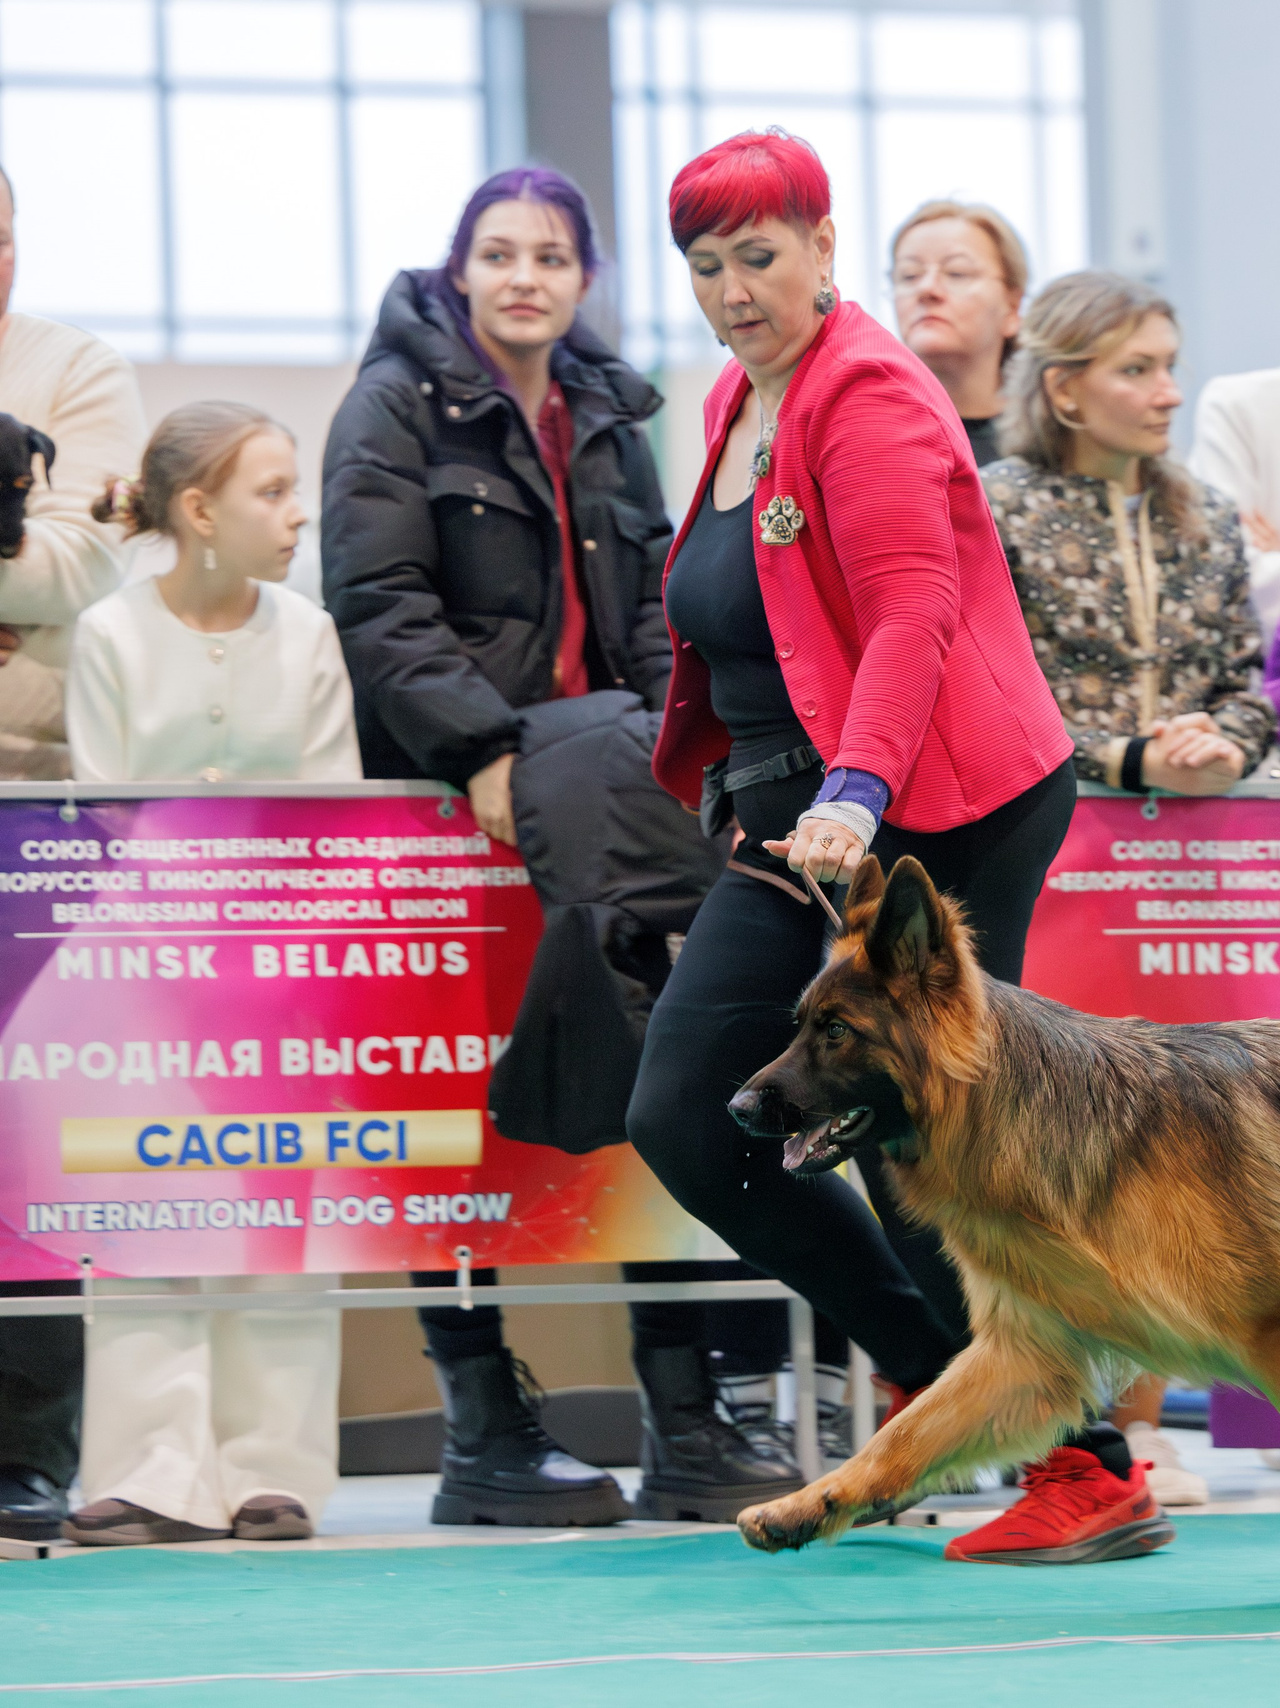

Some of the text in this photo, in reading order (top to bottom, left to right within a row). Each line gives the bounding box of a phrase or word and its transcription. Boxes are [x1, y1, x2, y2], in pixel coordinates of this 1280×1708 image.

[20, 831, 491, 863] СОЮЗ ОБЩЕСТВЕННЫХ ОБЪЕДИНЕНИЙ
[148, 868, 374, 891] КИНОЛОГИЧЕСКОЕ
[52, 897, 468, 923] BELORUSSIAN CINOLOGICAL UNION
[57, 941, 470, 980] MINSK BELARUS
[1139, 941, 1280, 976] MINSK
[0, 1039, 263, 1085] АРОДНАЯ
[136, 1119, 408, 1168] CACIB FCI
[26, 1192, 513, 1233] INTERNATIONAL DOG SHOW
